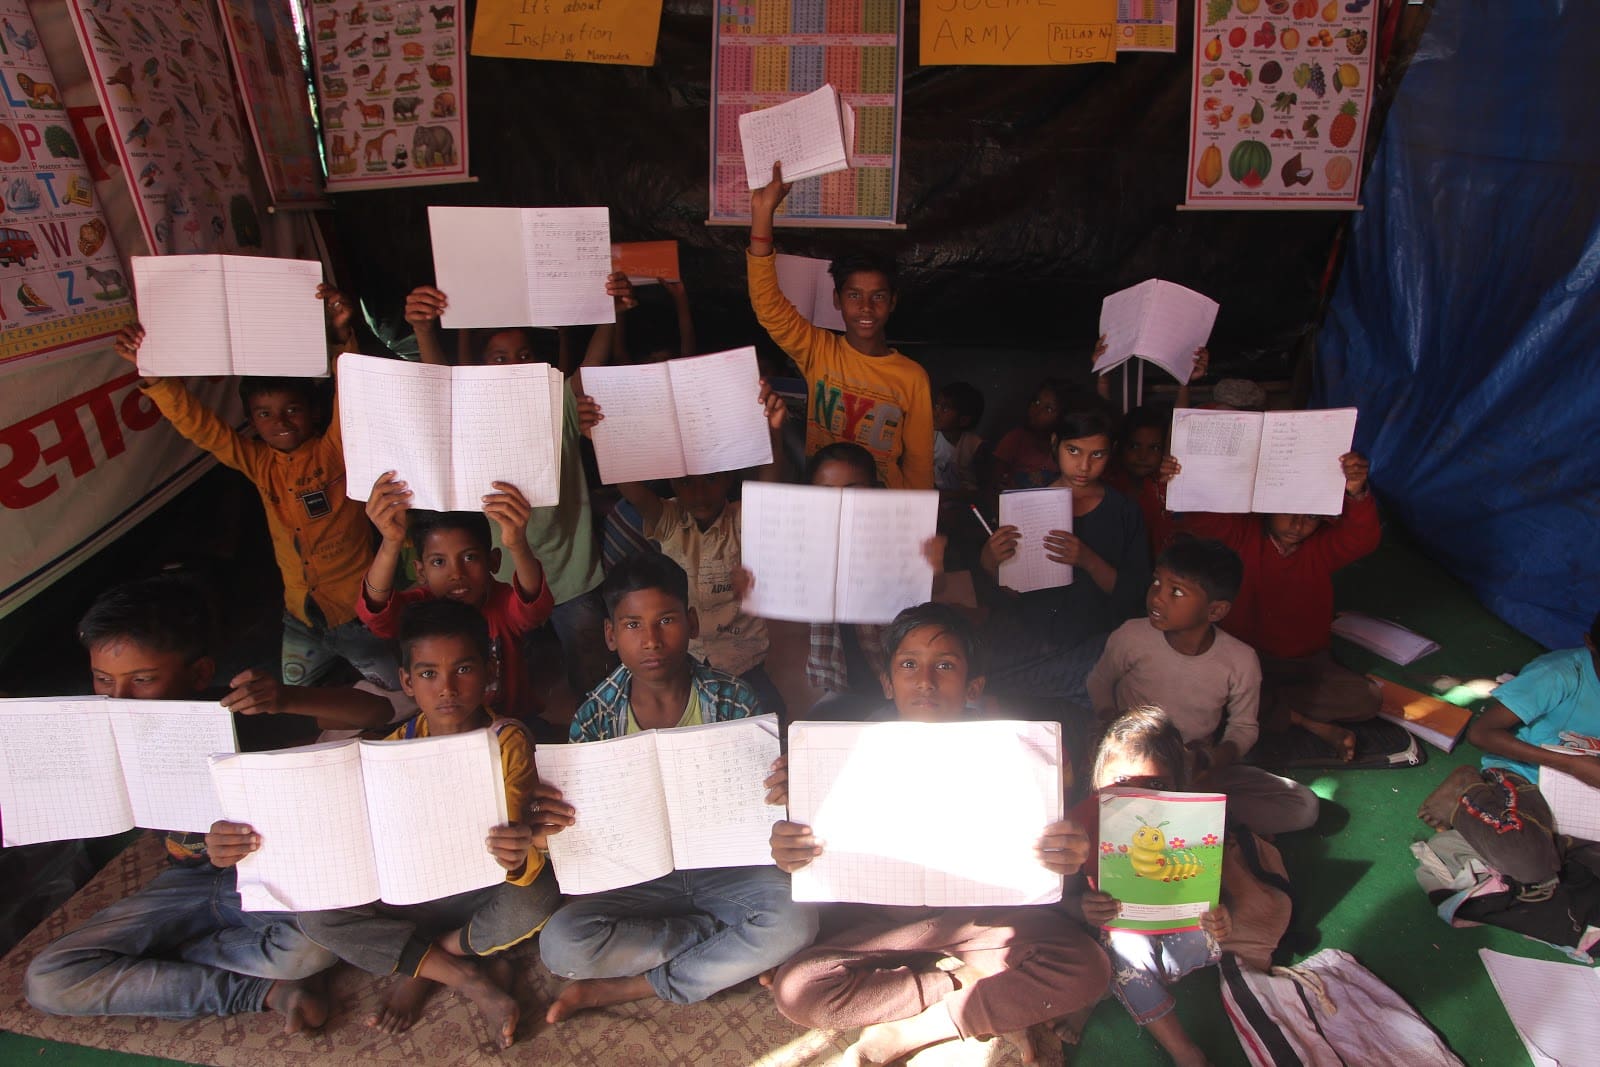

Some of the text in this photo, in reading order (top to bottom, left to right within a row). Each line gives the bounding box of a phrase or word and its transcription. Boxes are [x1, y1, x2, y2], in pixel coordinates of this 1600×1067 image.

[504, 23, 614, 50] Inspiration
[742, 25, 751, 34] 10
[933, 18, 1021, 52] ARMY
[1063, 46, 1096, 60] 755
[18, 122, 41, 160] P
[35, 171, 60, 208] T
[38, 221, 71, 258] W
[57, 270, 84, 305] Z
